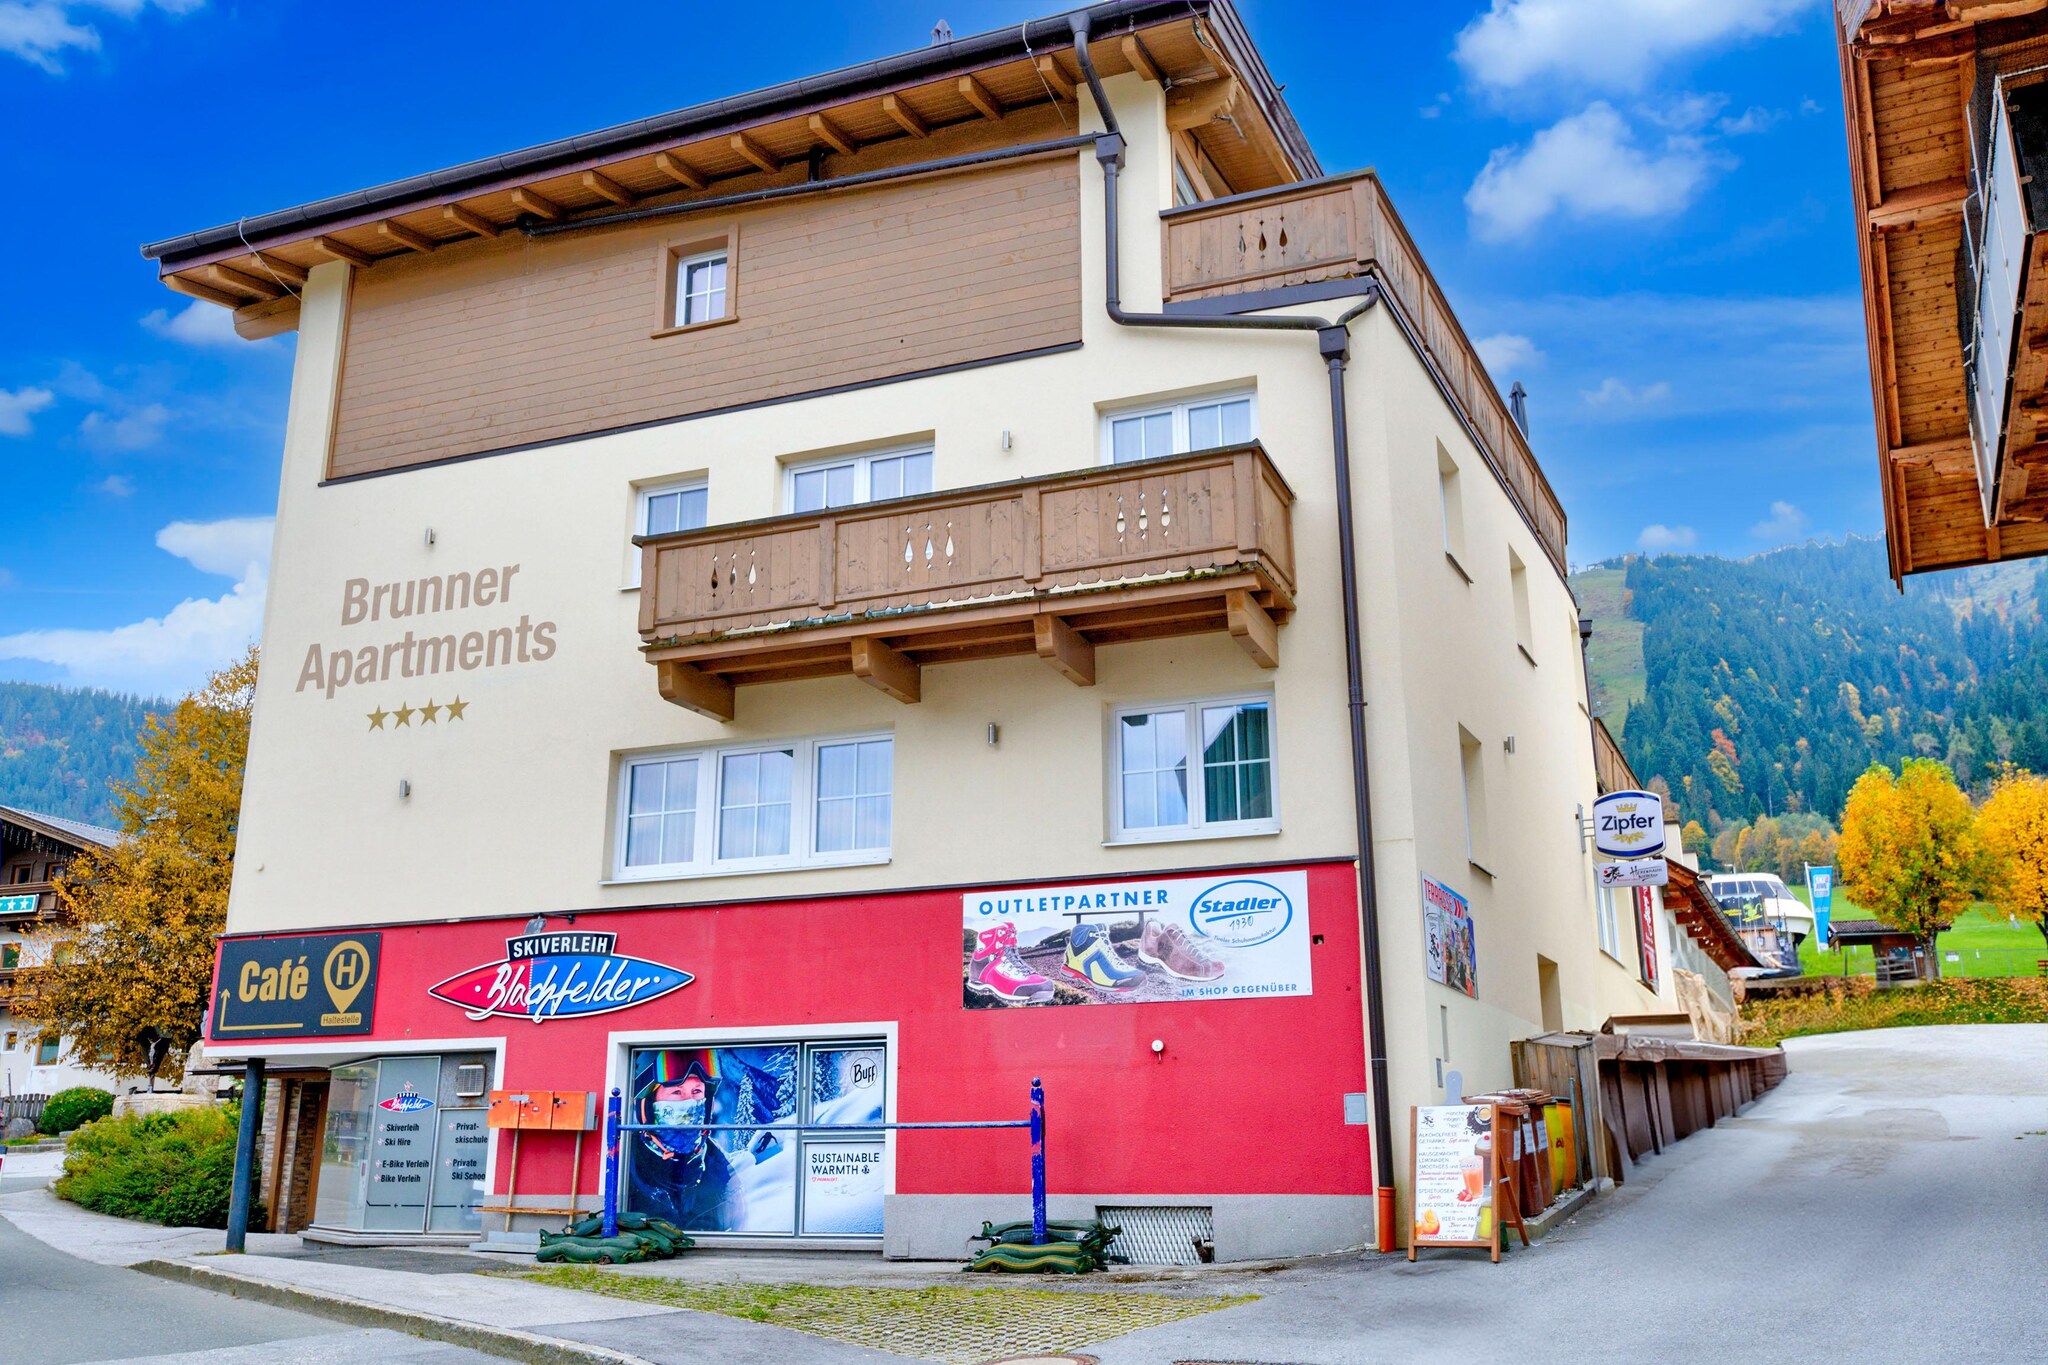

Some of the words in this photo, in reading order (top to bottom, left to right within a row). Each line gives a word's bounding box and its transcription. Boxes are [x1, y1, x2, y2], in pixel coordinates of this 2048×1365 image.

[341, 564, 520, 625] Brunner
[296, 615, 557, 699] Apartments
[1601, 814, 1655, 834] Zipfer
[979, 889, 1169, 916] OUTLETPARTNER
[1199, 897, 1282, 913] Stadler
[1229, 916, 1254, 931] 1930
[513, 936, 609, 958] SKIVERLEIH
[336, 953, 358, 986] H
[239, 956, 310, 1003] Café
[465, 959, 651, 1024] Blachfelder
[1183, 988, 1195, 997] IM
[1200, 986, 1228, 996] SHOP
[1233, 982, 1298, 994] GEGENÜBER
[322, 1015, 361, 1025] Haltestelle
[386, 1124, 420, 1132] Skiverleih
[456, 1122, 480, 1131] Privat-
[384, 1138, 396, 1146] Ski
[397, 1138, 411, 1146] Hire
[455, 1135, 488, 1144] skischule
[406, 1160, 430, 1168] Verleih
[452, 1158, 477, 1167] Private
[811, 1152, 880, 1164] SUSTAINABLE
[451, 1171, 463, 1180] Ski
[464, 1171, 486, 1180] Schoo
[811, 1164, 859, 1175] WARMTH
[380, 1174, 396, 1183] Bike
[397, 1174, 421, 1182] Verleih
